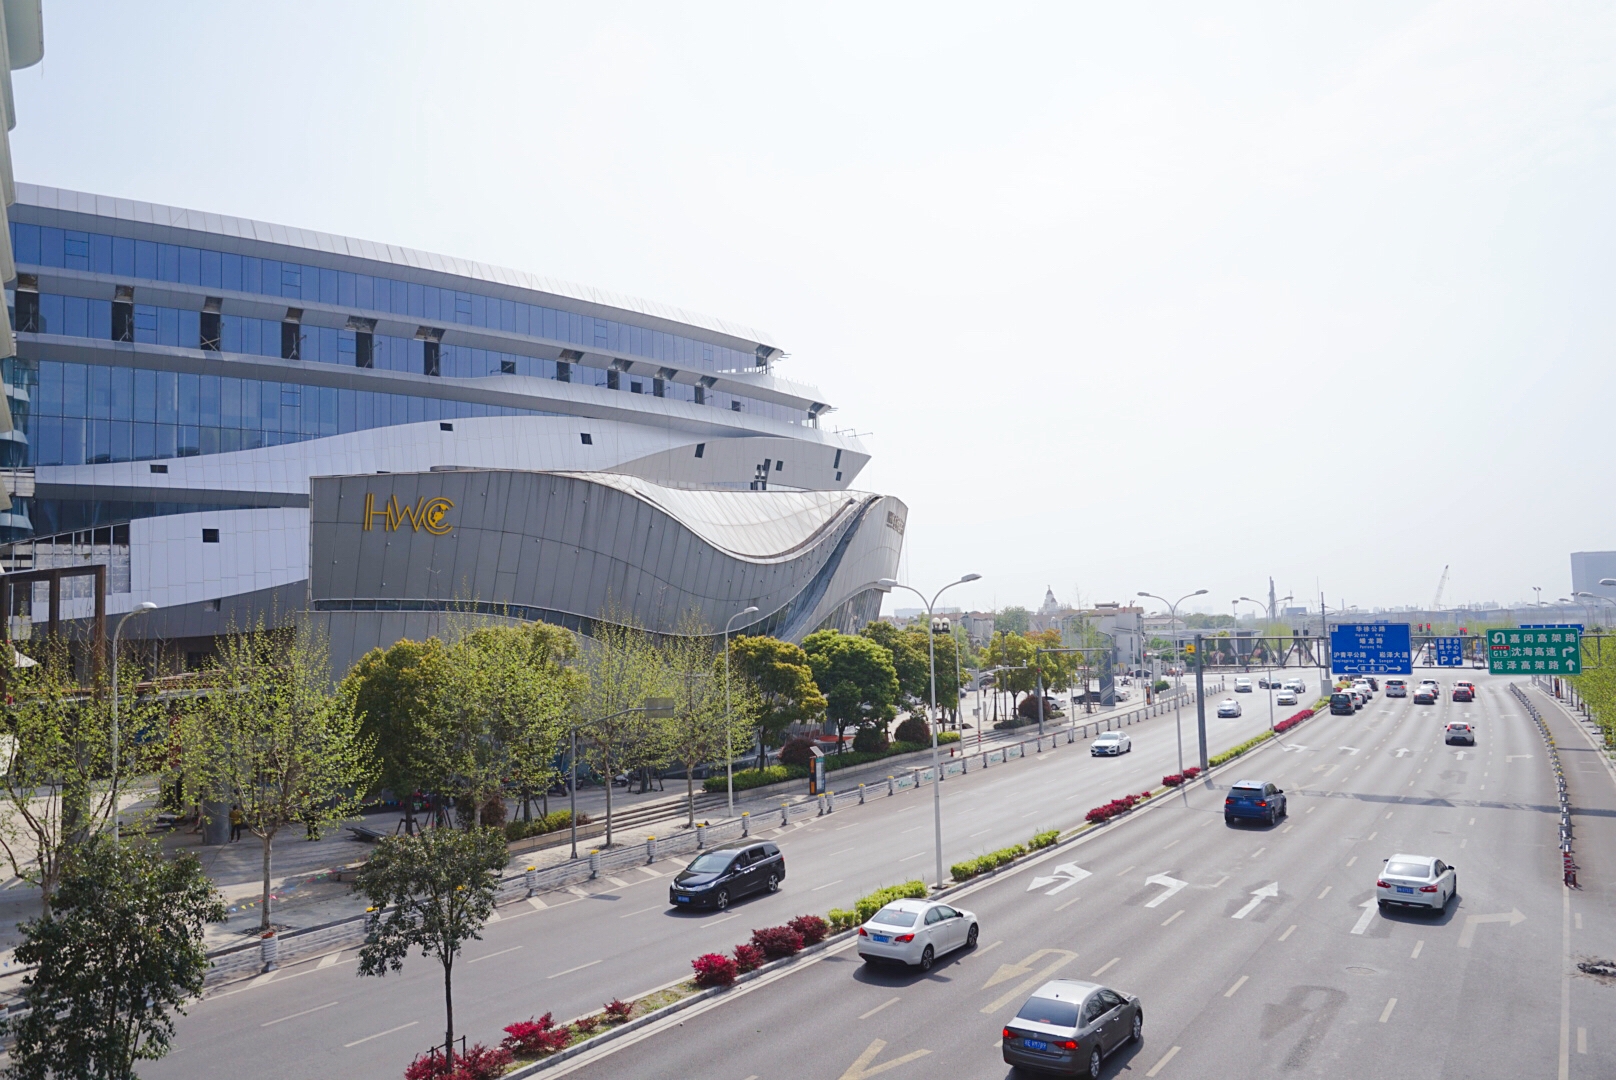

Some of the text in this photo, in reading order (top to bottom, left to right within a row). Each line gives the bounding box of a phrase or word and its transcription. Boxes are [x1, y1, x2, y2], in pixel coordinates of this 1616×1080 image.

[1510, 633, 1576, 643] 嘉闵高架路
[1511, 647, 1556, 656] 沈海高速
[1441, 656, 1448, 664] P
[1493, 661, 1559, 670] 崧泽高架路
